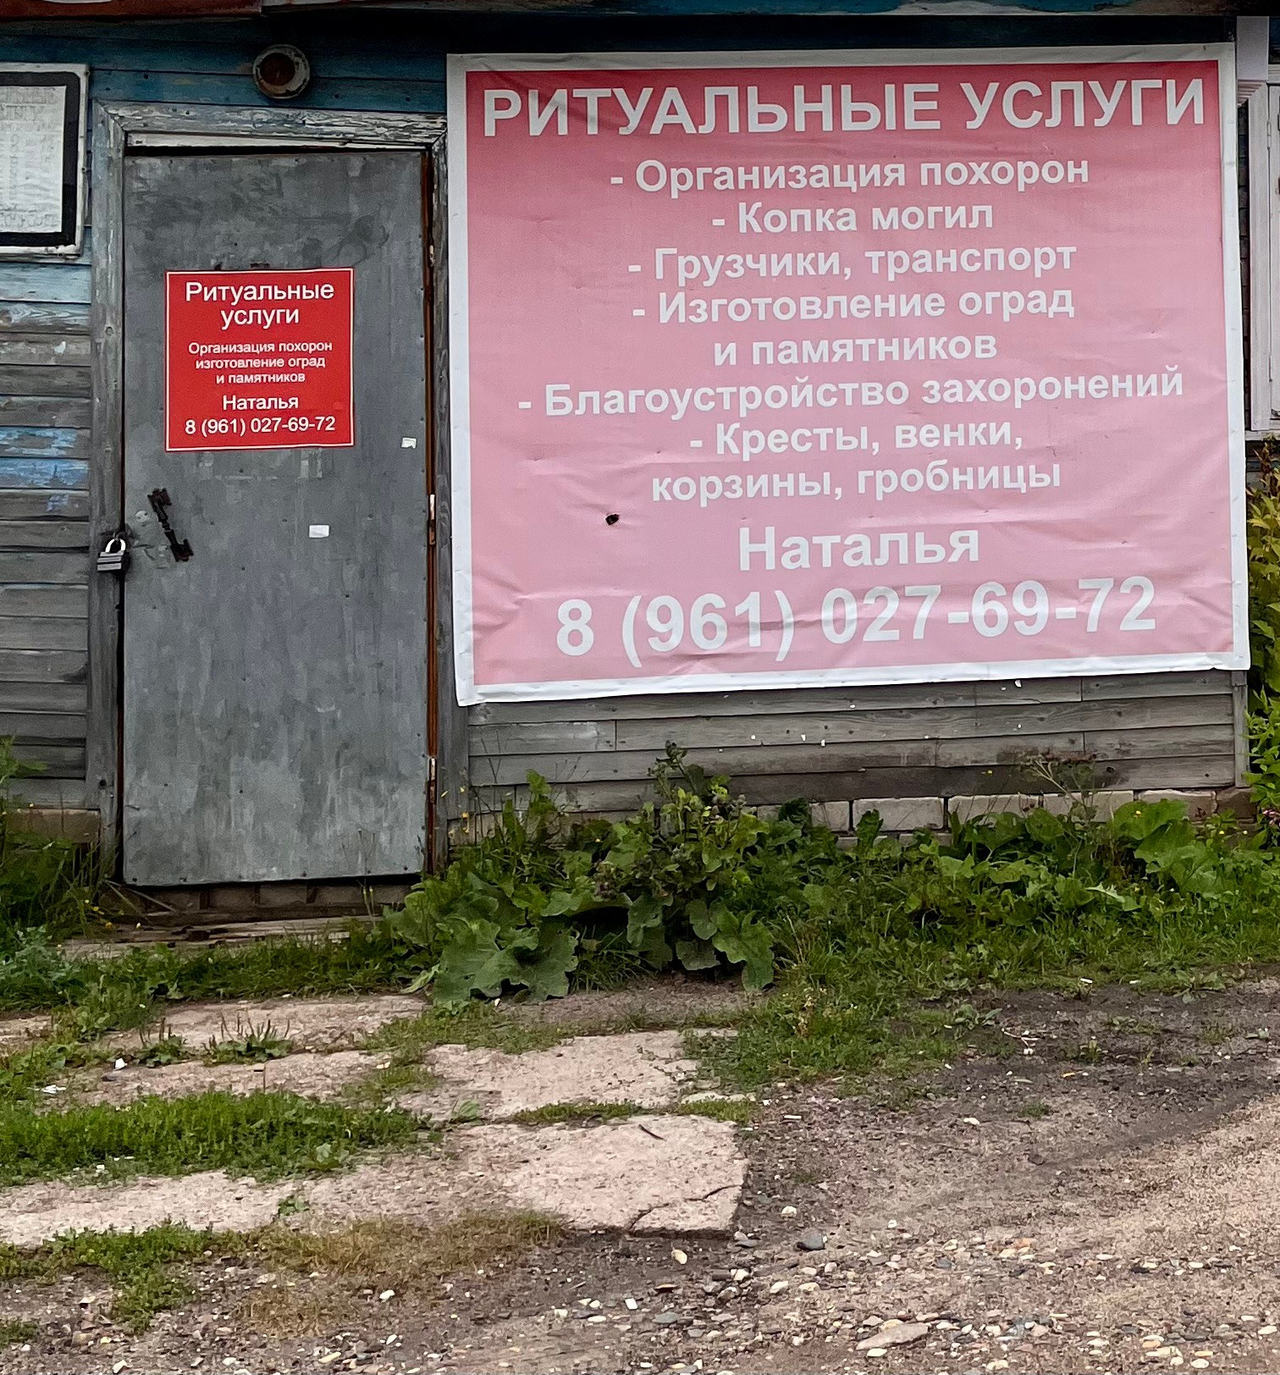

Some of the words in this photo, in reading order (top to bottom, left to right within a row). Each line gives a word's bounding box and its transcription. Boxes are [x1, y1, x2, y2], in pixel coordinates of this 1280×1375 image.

[484, 83, 942, 138] РИТУАЛЬНЫЕ
[963, 80, 1205, 131] УСЛУГИ
[636, 159, 906, 192] Организация
[921, 158, 1090, 189] похорон
[739, 203, 857, 234] Копка
[873, 204, 994, 232] могил
[656, 248, 852, 286] Грузчики,
[866, 243, 1078, 278] транспорт
[184, 281, 335, 306] Ритуальные
[660, 291, 946, 325] Изготовление
[959, 290, 1077, 321] оград
[220, 308, 299, 330] услуги
[188, 342, 275, 355] Организация
[278, 342, 333, 354] похорон
[195, 358, 285, 370] изготовление
[287, 357, 326, 369] оград
[714, 344, 738, 367] и
[752, 335, 999, 366] памятников
[216, 375, 225, 384] и
[228, 372, 306, 384] памятников
[546, 378, 910, 418] Благоустройство
[923, 366, 1184, 406] захоронений
[222, 395, 299, 411] Наталья
[184, 420, 197, 434] 8
[201, 418, 246, 437] (961)
[250, 416, 336, 432] 027-69-72
[716, 424, 881, 460] Кресты,
[895, 421, 1024, 450] венки,
[652, 470, 845, 507] корзины,
[857, 461, 1062, 502] гробницы
[739, 528, 981, 572] Наталья
[557, 599, 594, 657] 8
[622, 592, 795, 666] (961)
[821, 577, 1158, 645] 027-69-72
